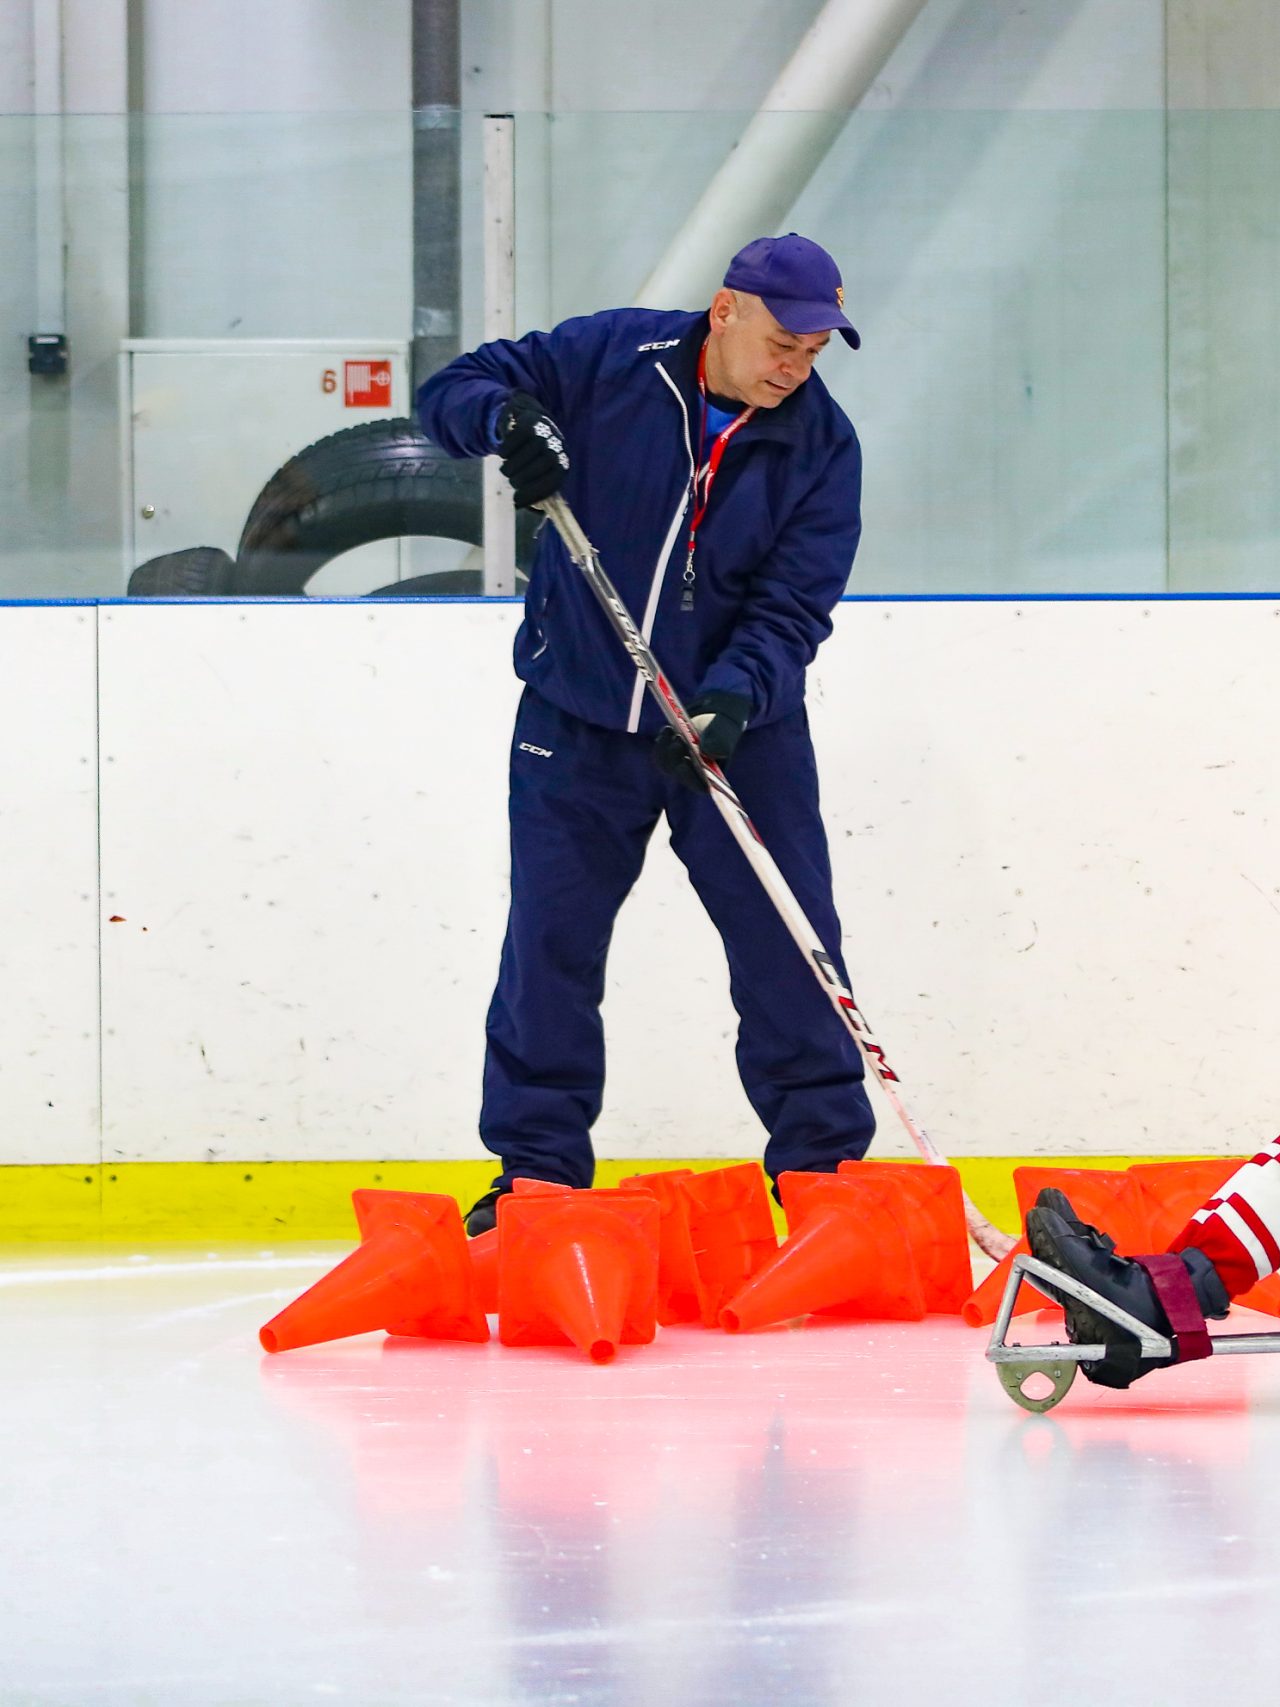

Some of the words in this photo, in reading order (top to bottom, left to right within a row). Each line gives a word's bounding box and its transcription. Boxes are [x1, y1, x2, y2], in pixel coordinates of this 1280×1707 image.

[637, 339, 681, 351] CCM
[321, 369, 337, 394] 6
[609, 598, 650, 652] CCM
[519, 742, 554, 758] CCM
[811, 949, 901, 1083] CCM
